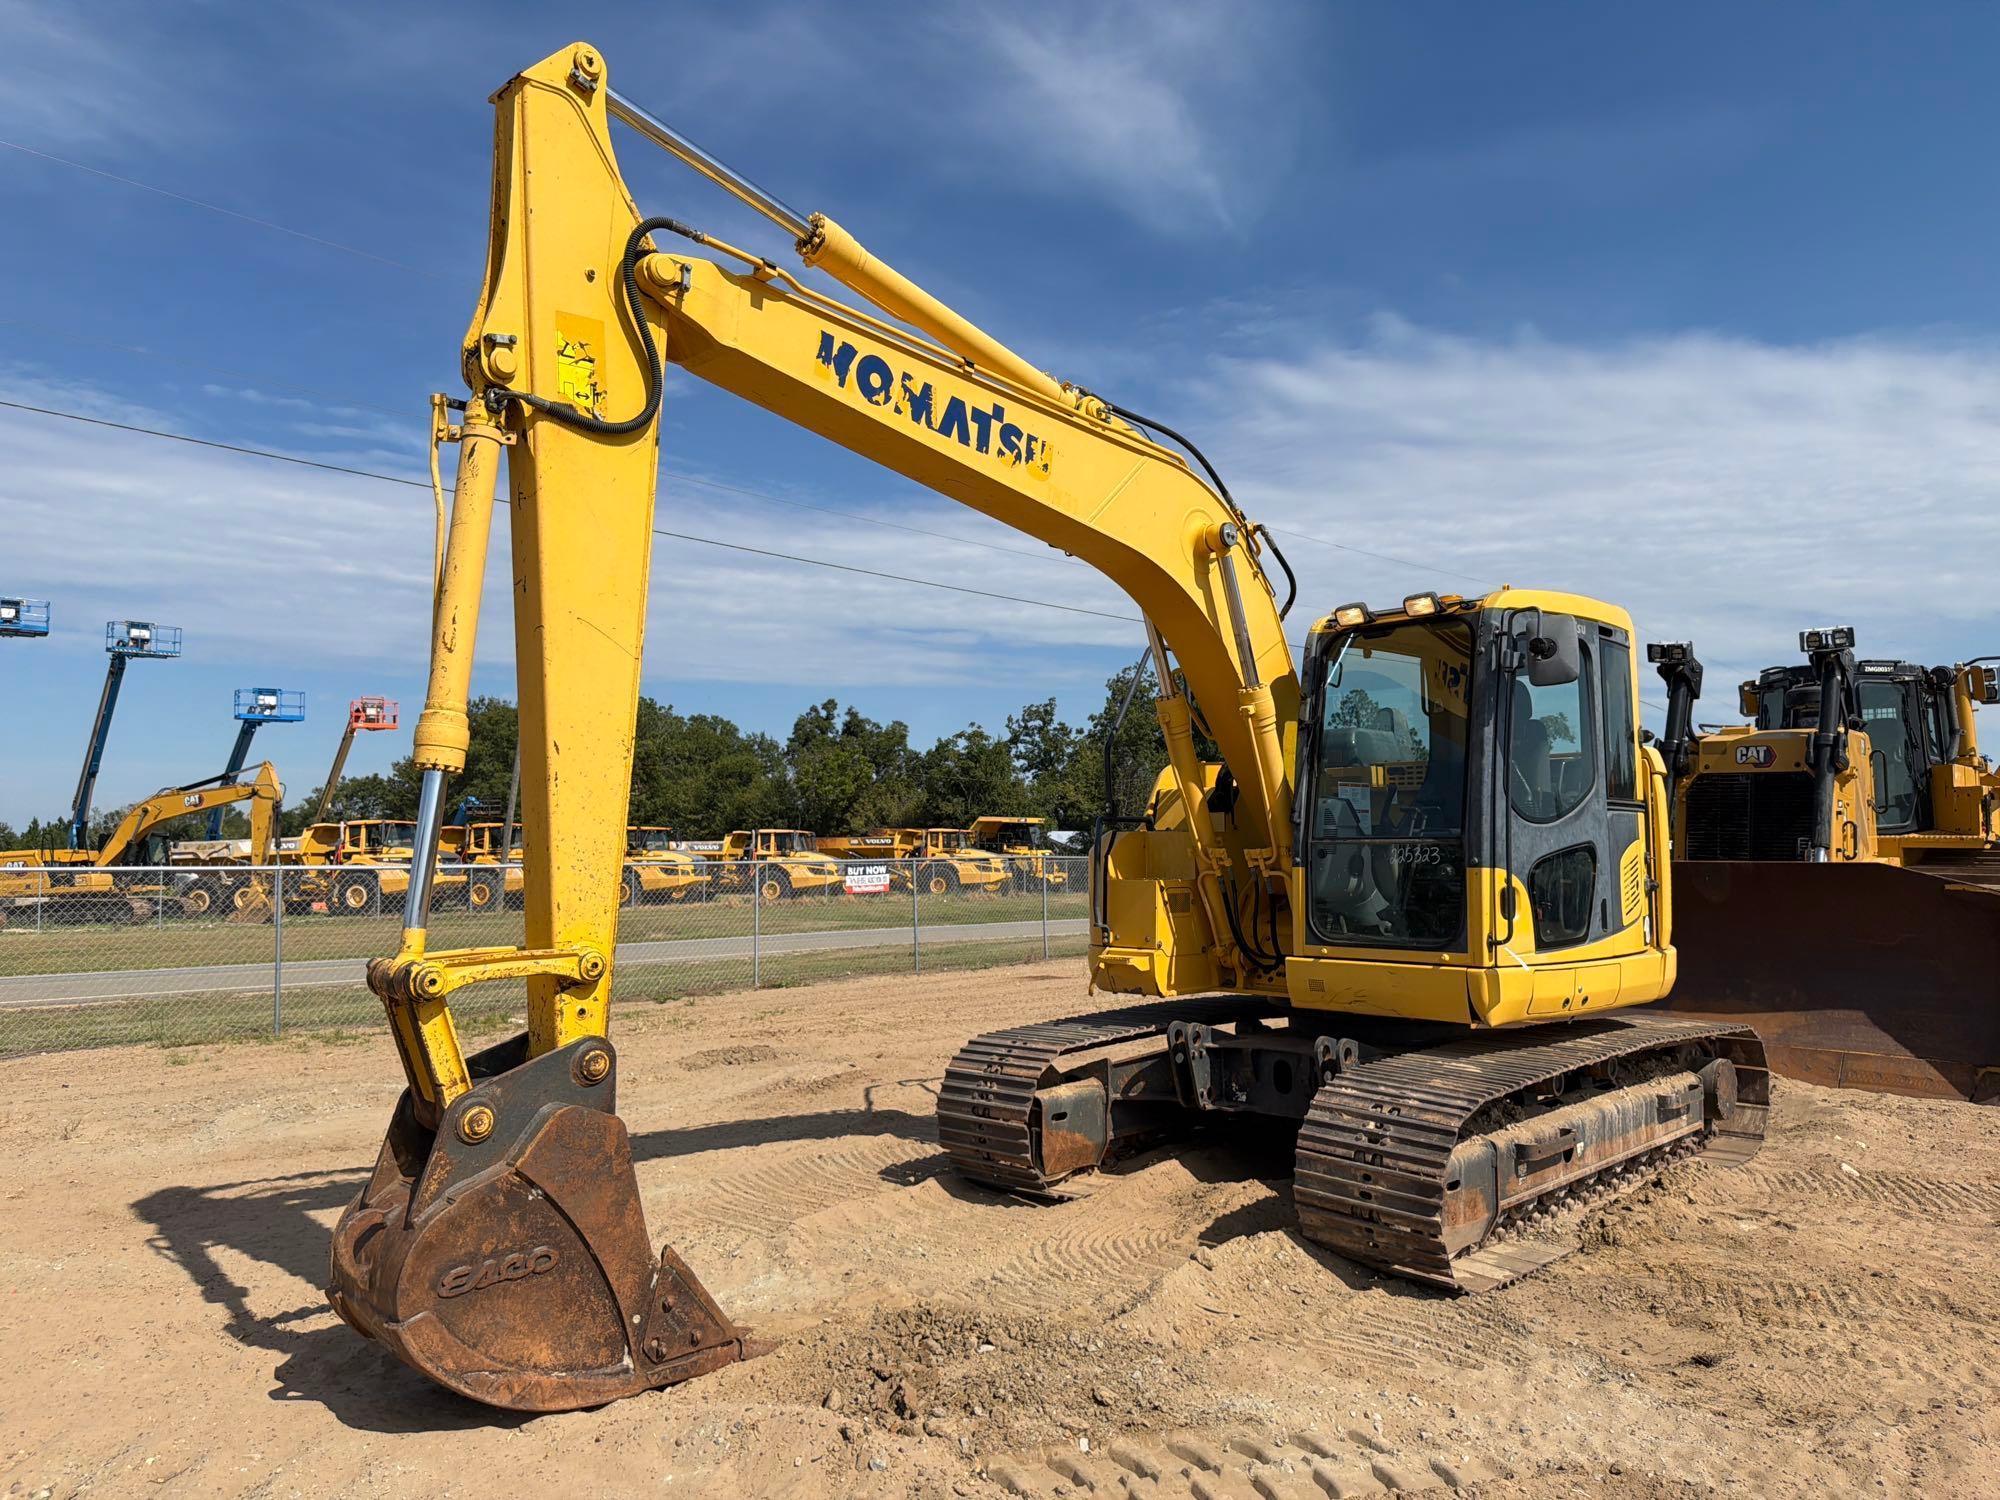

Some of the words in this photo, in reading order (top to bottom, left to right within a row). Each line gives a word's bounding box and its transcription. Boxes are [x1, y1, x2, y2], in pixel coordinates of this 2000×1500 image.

[1736, 746, 1767, 764] CAT
[184, 794, 200, 807] CAT
[1389, 846, 1441, 865] 225323
[847, 866, 864, 875] BUY
[866, 865, 887, 874] NOW
